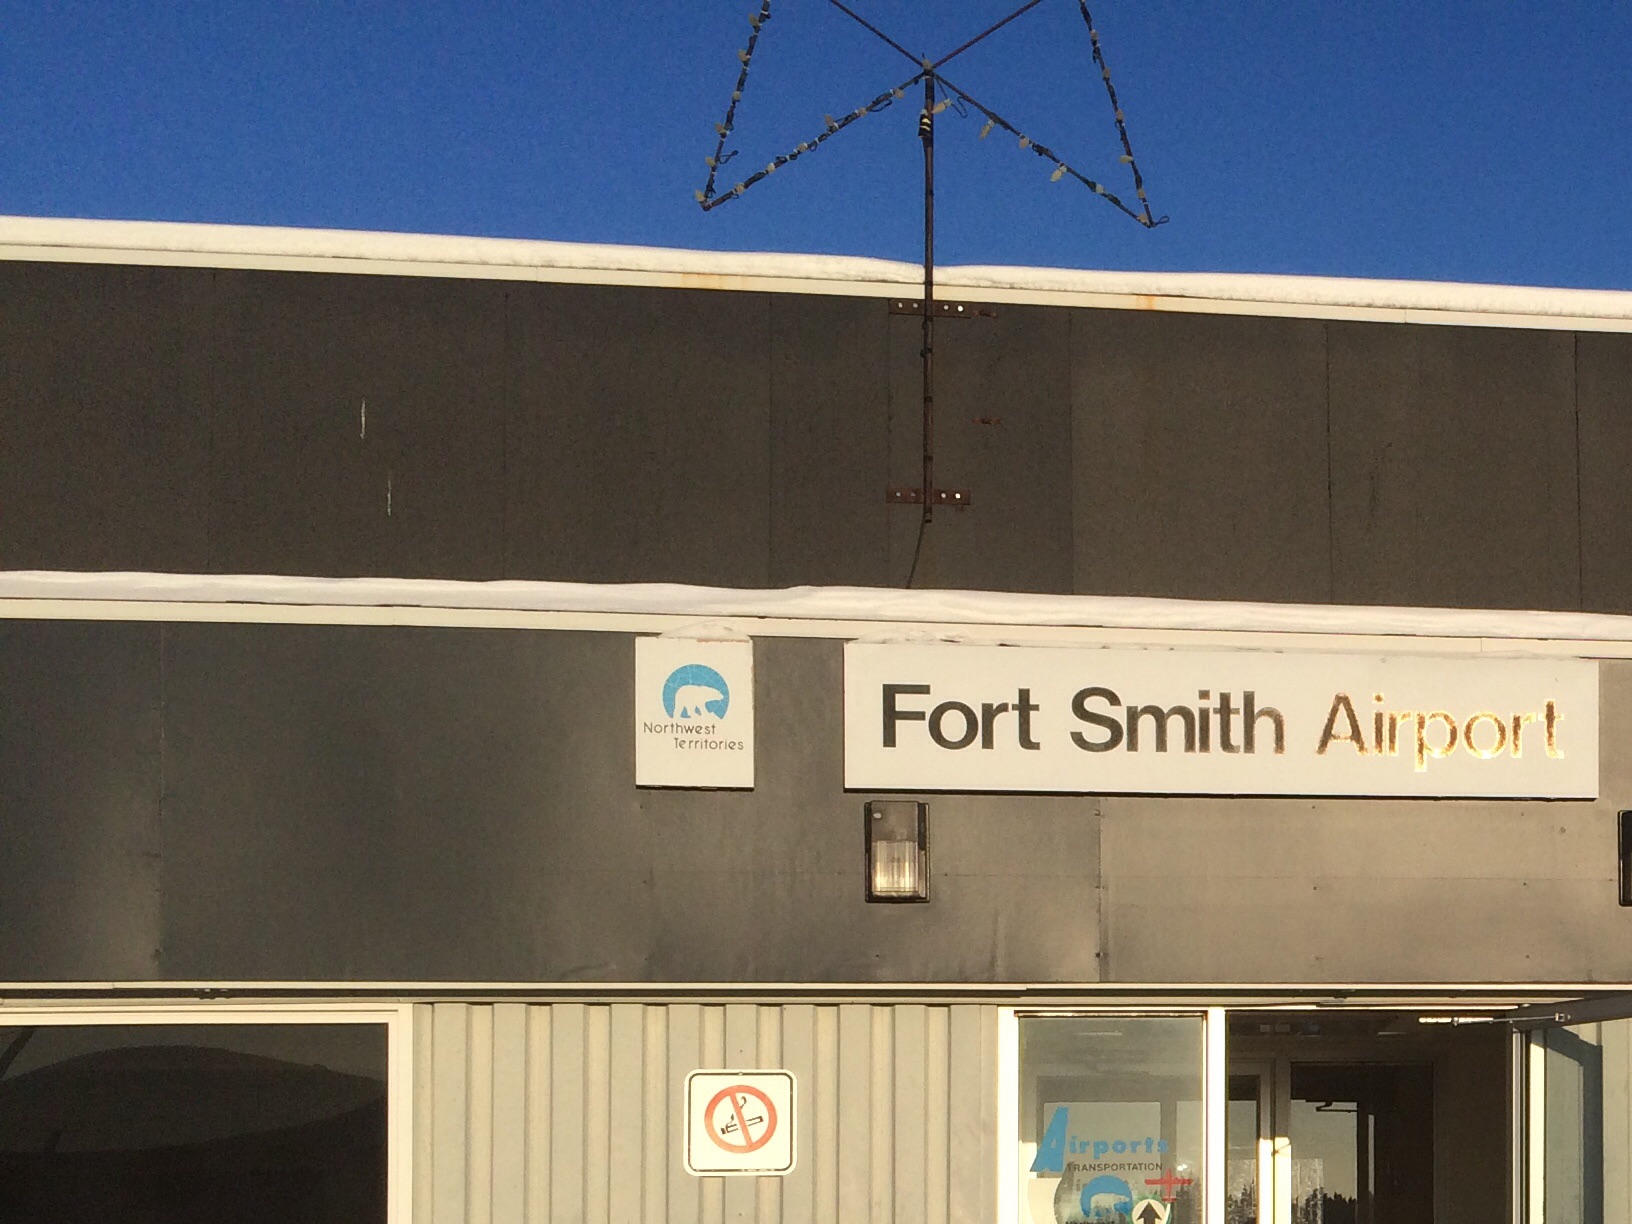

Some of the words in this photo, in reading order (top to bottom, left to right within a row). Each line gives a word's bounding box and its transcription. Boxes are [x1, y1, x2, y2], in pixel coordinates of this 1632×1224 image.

[643, 721, 716, 735] Northwest
[882, 683, 1041, 750] Fort
[1070, 686, 1285, 755] Smith
[1315, 693, 1565, 773] Airport
[674, 737, 744, 750] Territories
[1030, 1106, 1168, 1172] Airports
[1067, 1162, 1163, 1172] TRANSPORTATION
